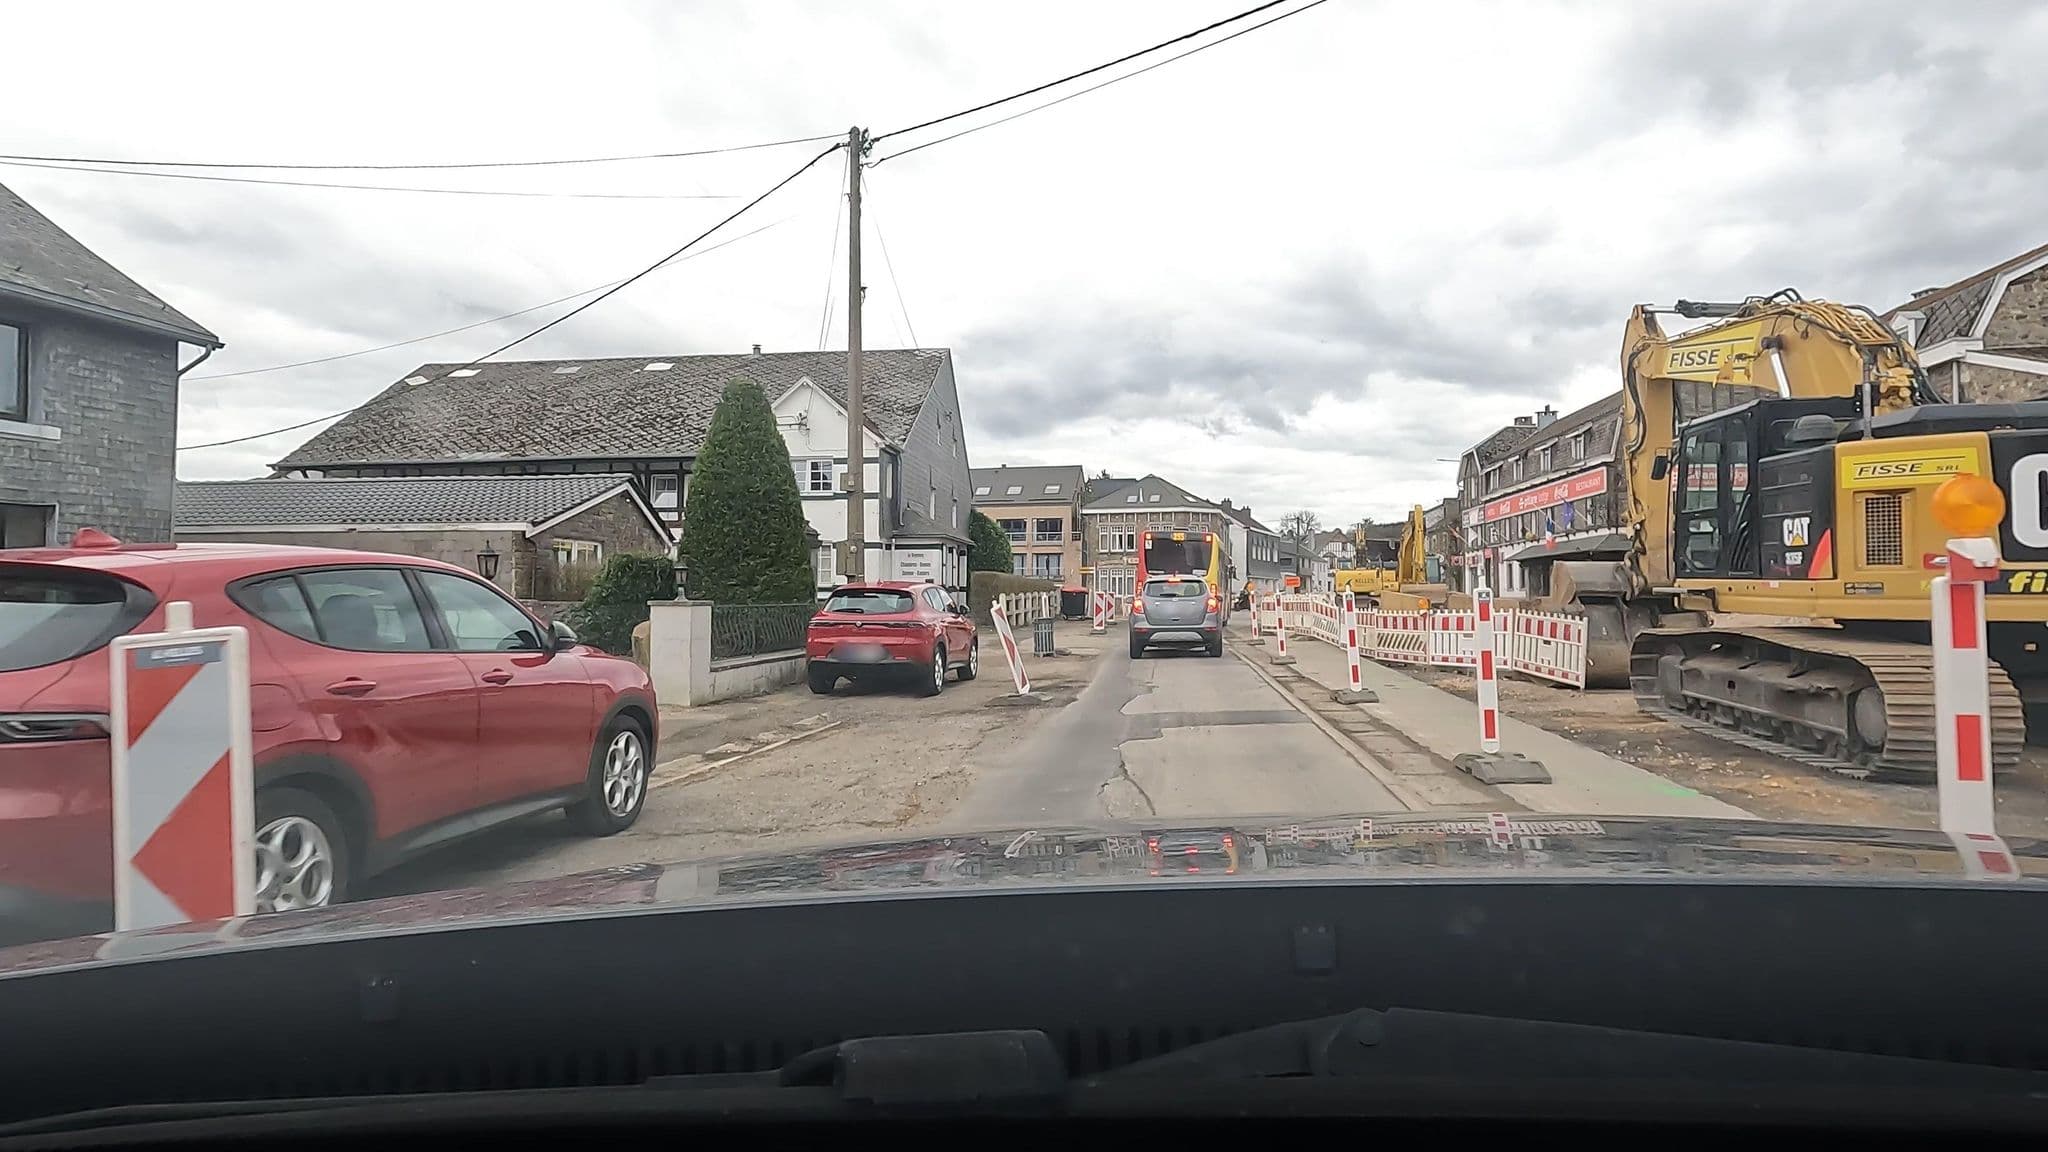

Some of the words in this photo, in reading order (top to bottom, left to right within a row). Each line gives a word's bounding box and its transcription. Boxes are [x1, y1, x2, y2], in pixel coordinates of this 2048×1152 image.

[1669, 349, 1720, 368] FISSE
[1857, 462, 1924, 476] FISSE
[1783, 517, 1810, 546] CAT
[2008, 571, 2048, 593] fi
